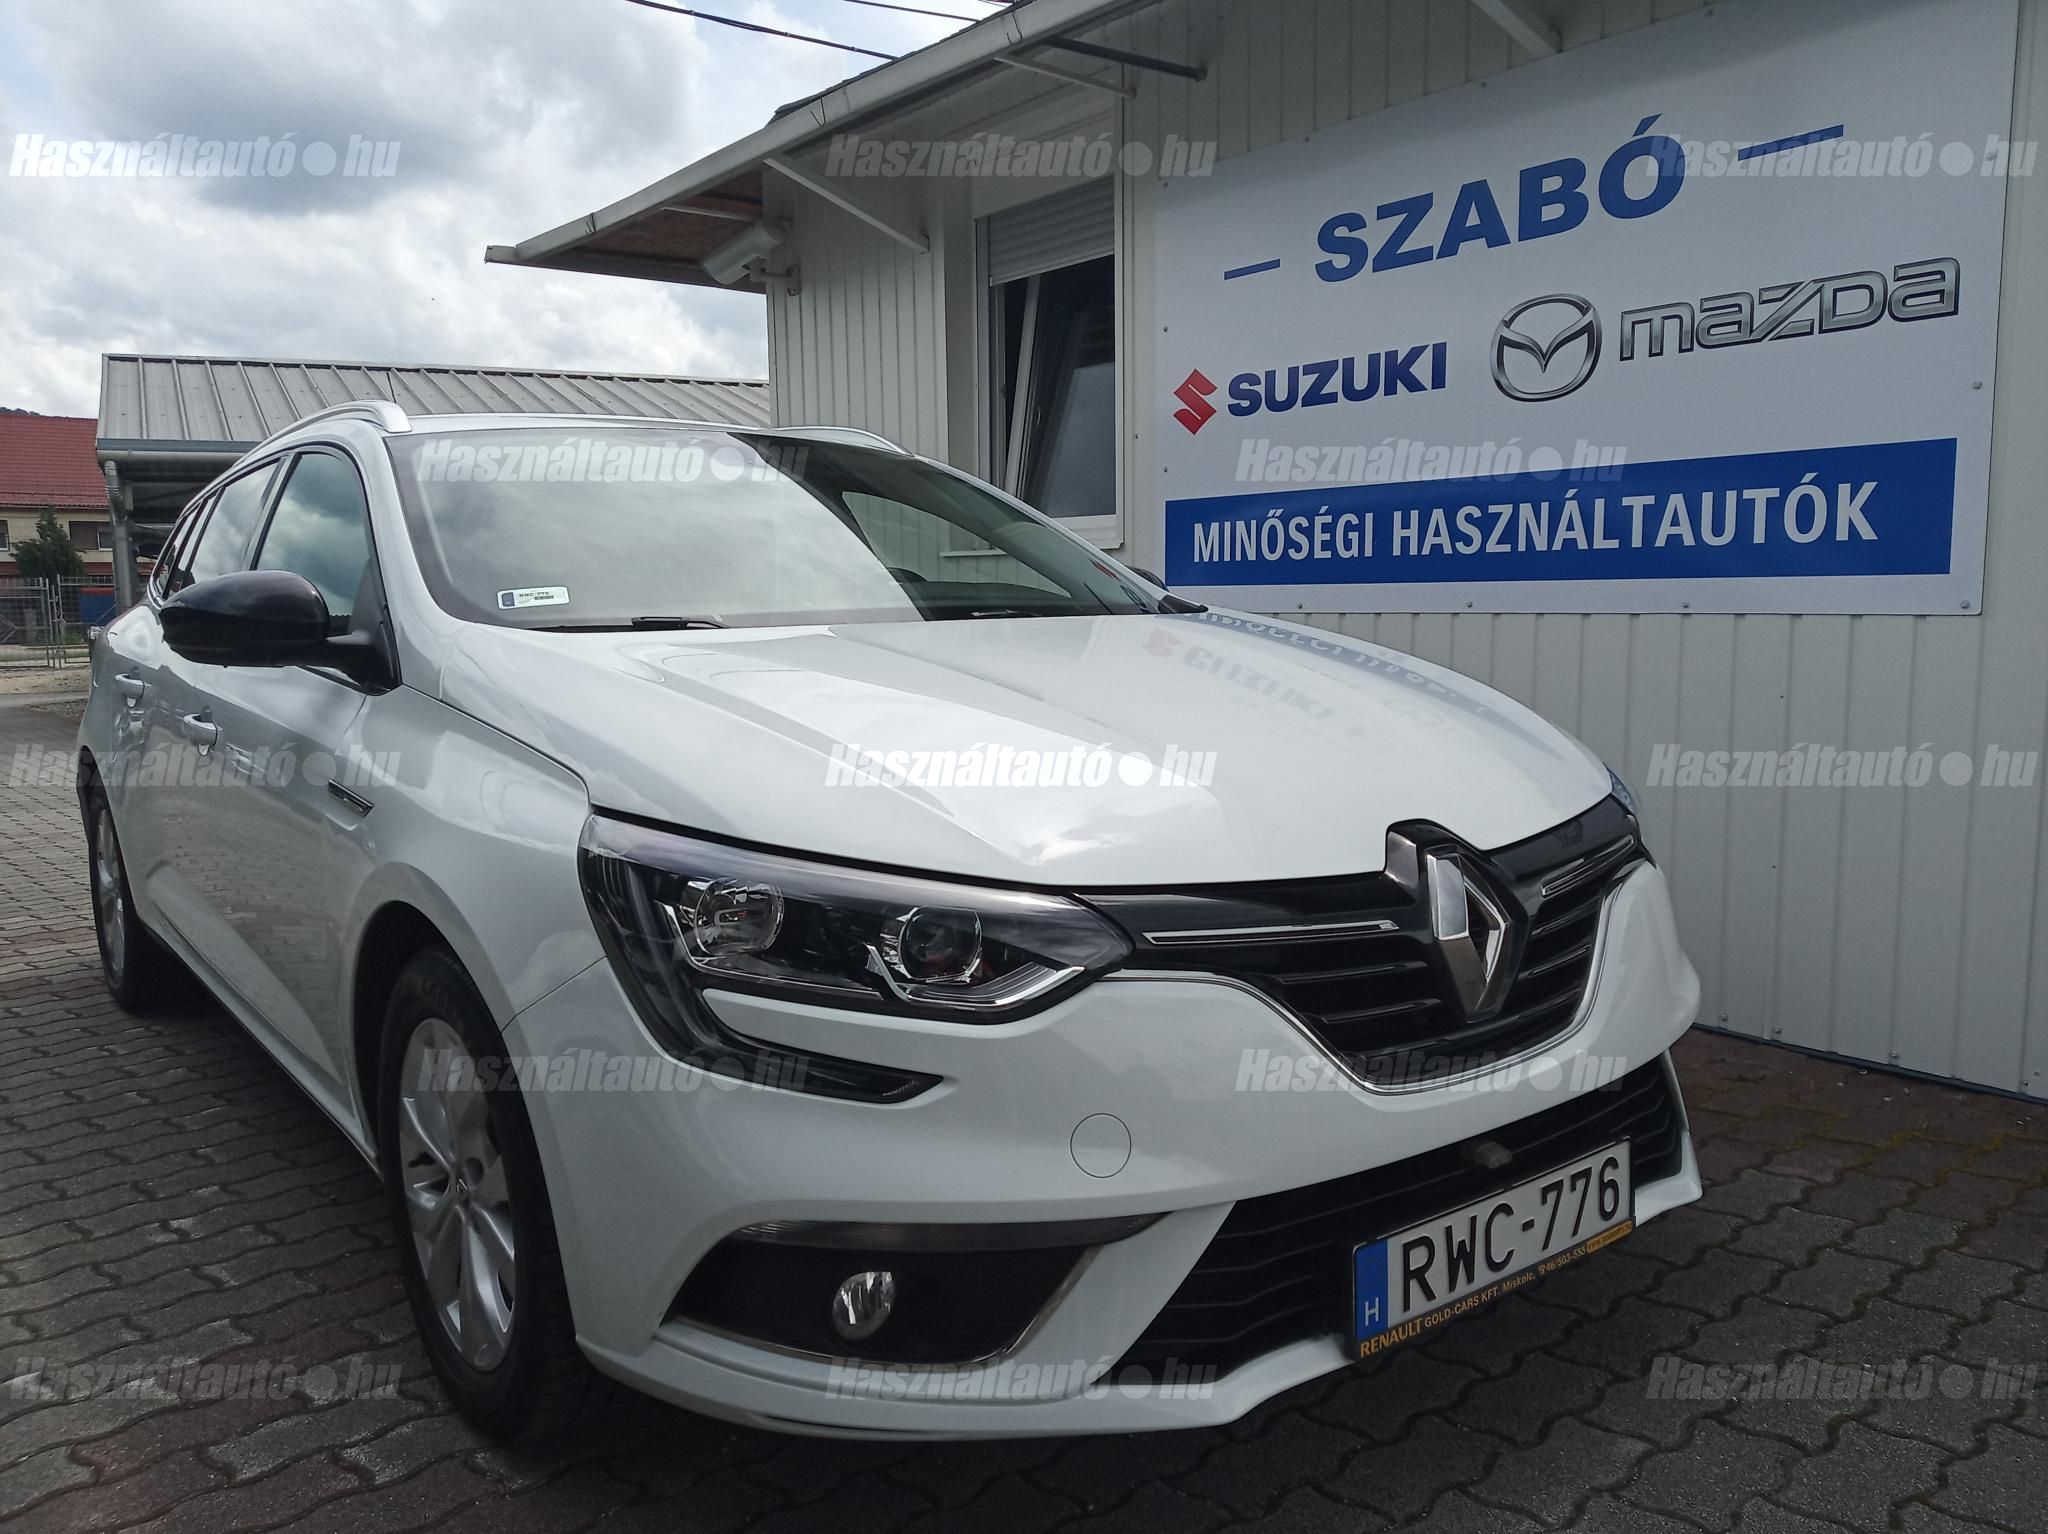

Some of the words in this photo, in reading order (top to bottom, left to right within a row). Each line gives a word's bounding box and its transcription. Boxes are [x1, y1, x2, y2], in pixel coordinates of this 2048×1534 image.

[1316, 112, 1687, 283] SZABÓ
[1227, 341, 1448, 418] SUZUKI
[1193, 504, 1374, 564] MINŐSÉGI
[1392, 473, 1879, 558] HASZNÁLTAUTÓK
[1402, 1155, 1620, 1314] RWC-776
[1360, 1317, 1423, 1358] RENAULT
[1364, 1296, 1380, 1327] H
